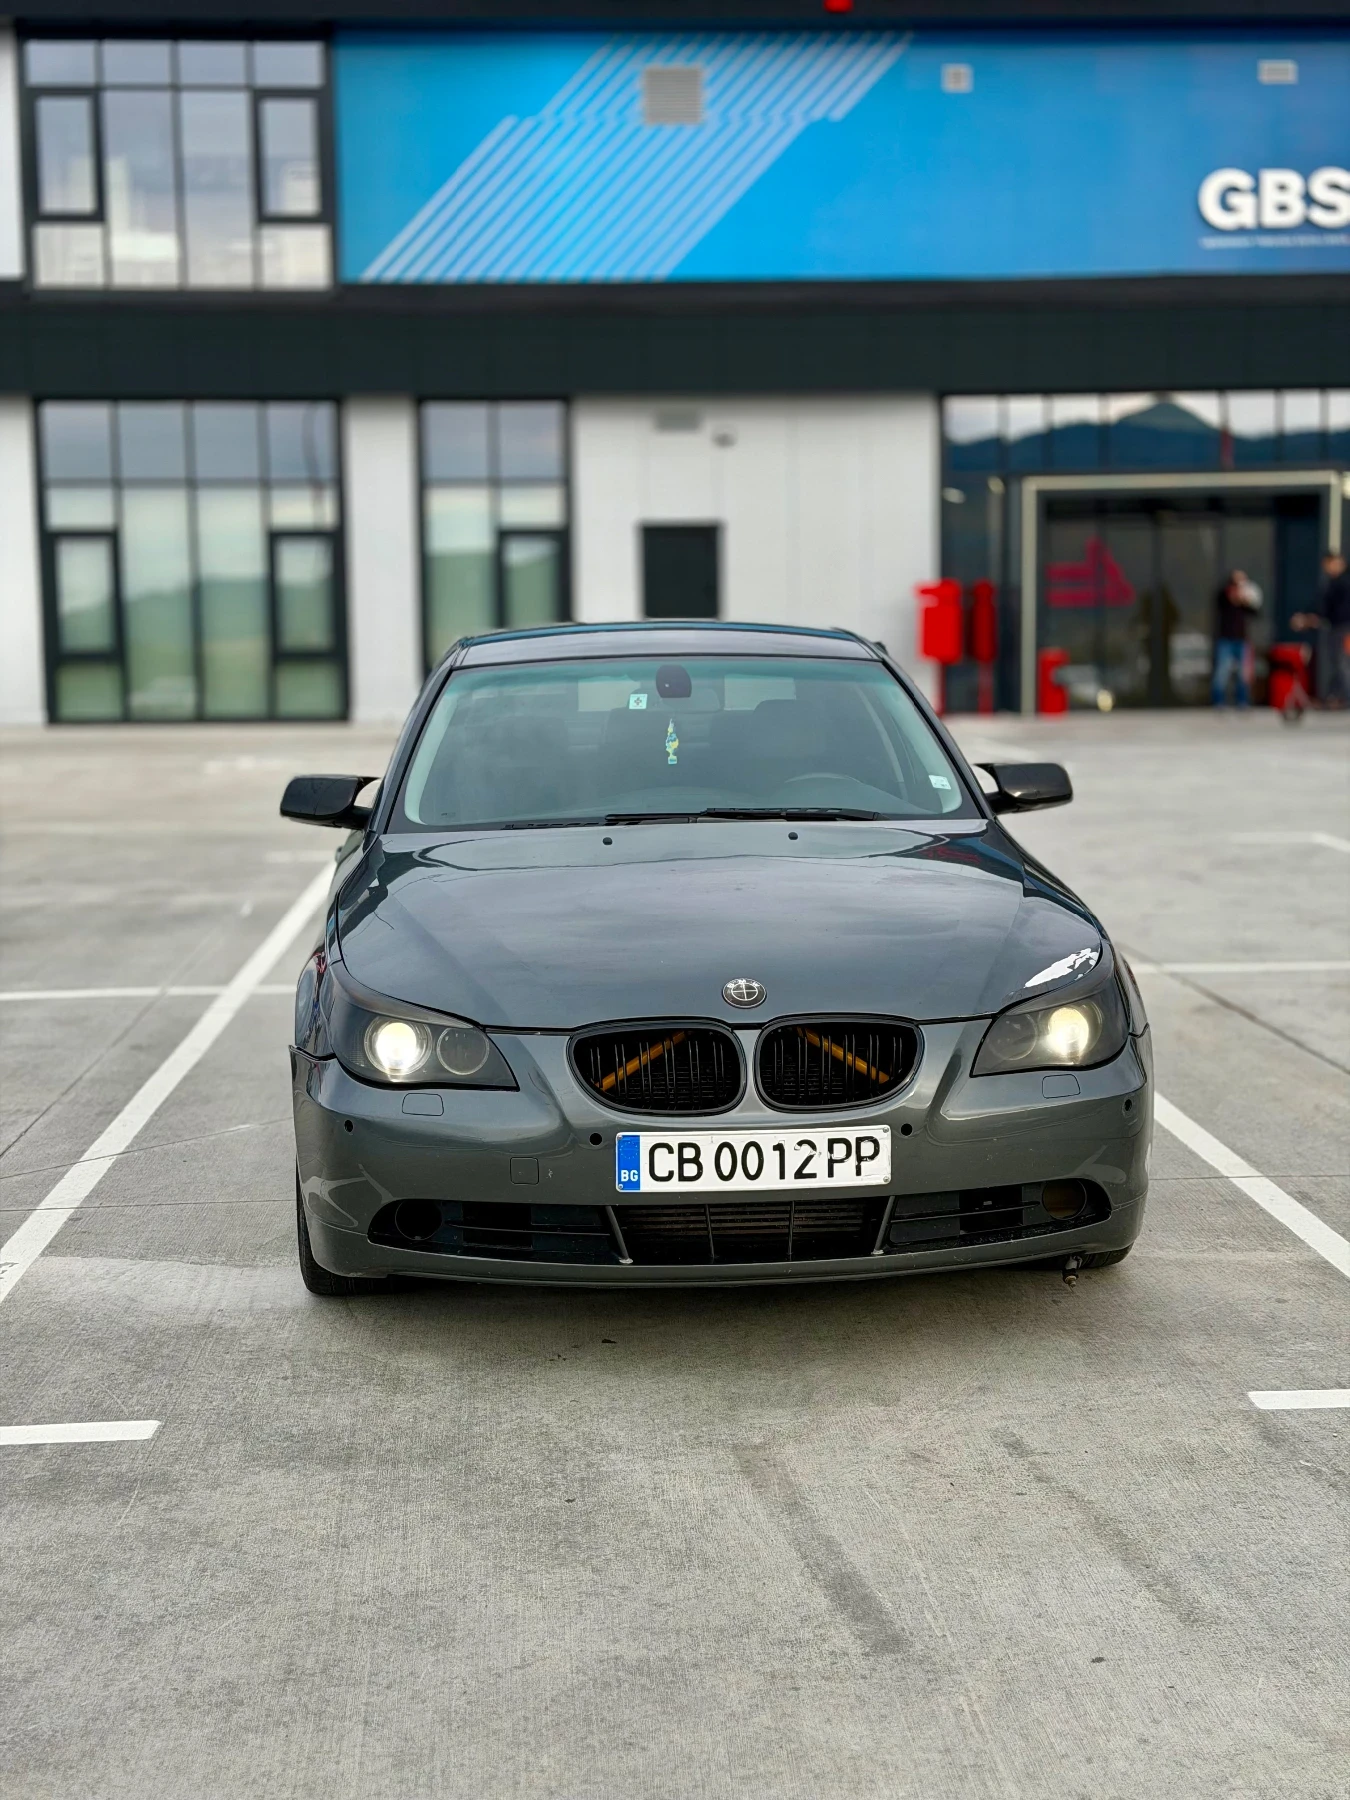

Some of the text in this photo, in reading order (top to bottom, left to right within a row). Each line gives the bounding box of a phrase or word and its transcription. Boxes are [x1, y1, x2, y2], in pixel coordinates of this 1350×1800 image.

[1198, 166, 1350, 231] GBS
[620, 1169, 639, 1182] BG
[714, 1139, 818, 1182] 0012
